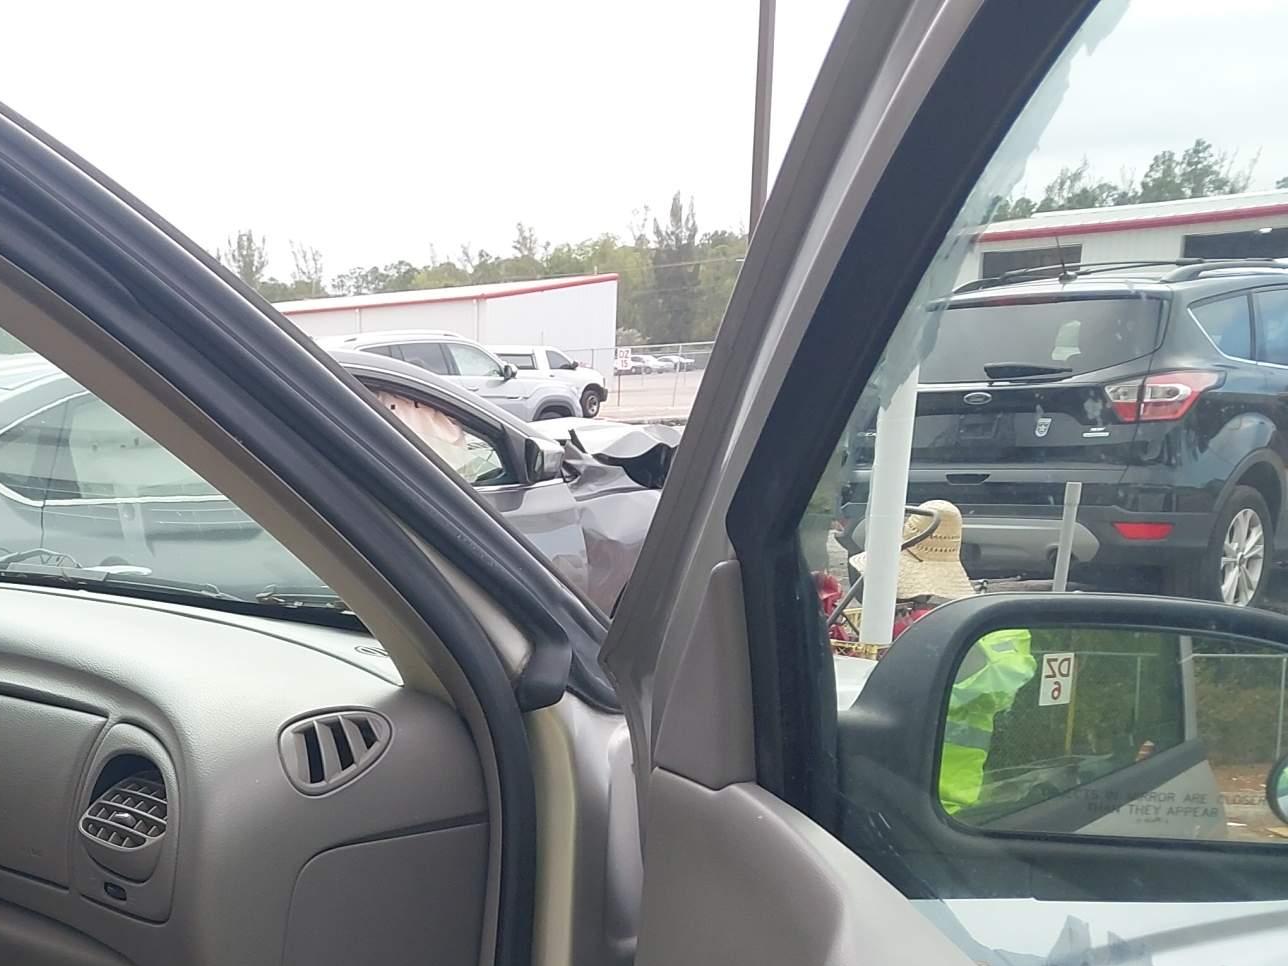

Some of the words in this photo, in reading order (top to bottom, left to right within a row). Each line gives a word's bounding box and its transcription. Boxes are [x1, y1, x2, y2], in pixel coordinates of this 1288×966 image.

[619, 350, 630, 358] DZ
[1183, 793, 1208, 804] ARE
[1129, 803, 1161, 815] THEY
